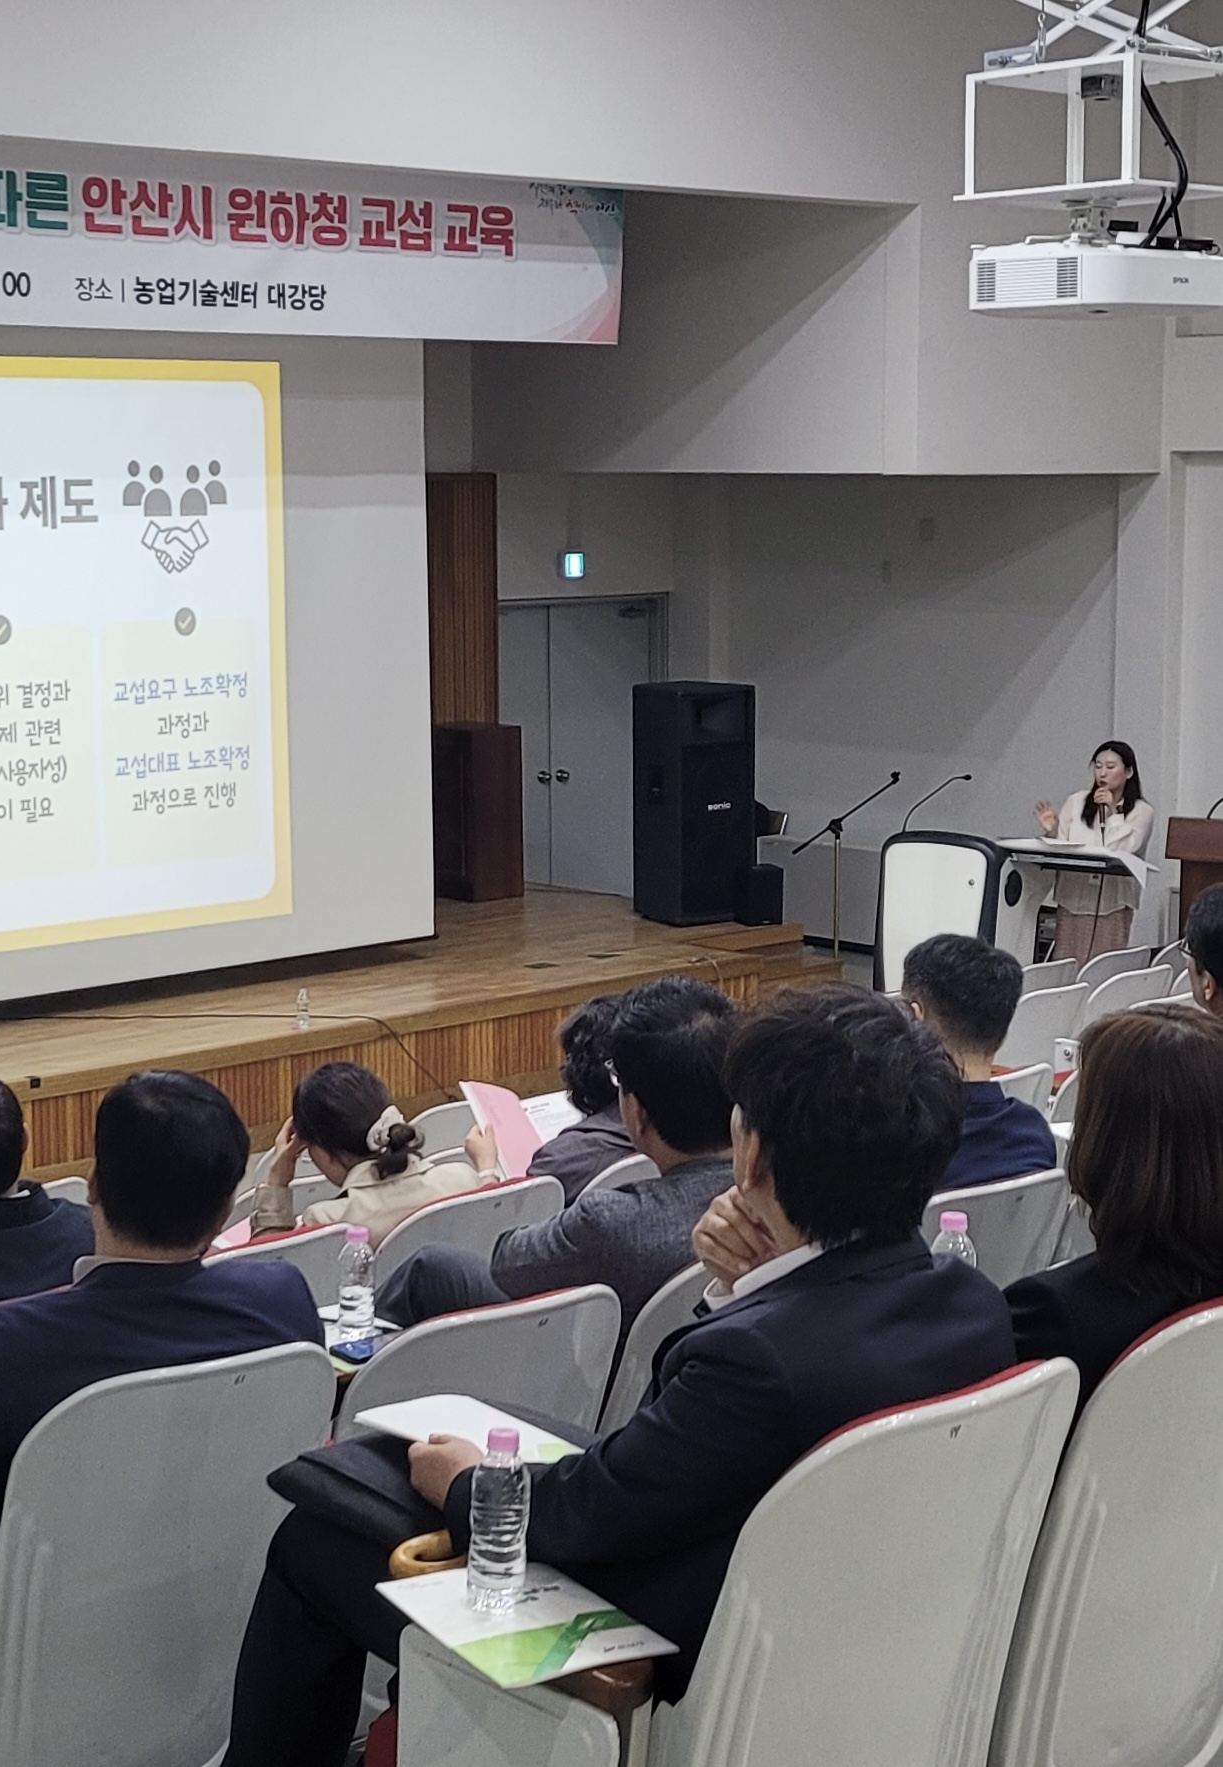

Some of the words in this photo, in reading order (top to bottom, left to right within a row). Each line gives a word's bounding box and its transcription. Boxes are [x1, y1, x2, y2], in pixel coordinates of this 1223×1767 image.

[82, 177, 213, 240] 안산시
[227, 188, 349, 249] 원하청
[359, 198, 432, 252] 교섭
[444, 204, 514, 256] 교육
[75, 277, 113, 301] 장소
[133, 277, 257, 308] 농업기술센터
[268, 283, 326, 311] 대강당
[20, 476, 98, 529] 제도
[16, 680, 70, 708] 결정과
[114, 679, 177, 704] 교섭요구
[184, 672, 247, 698] 노조확정
[26, 718, 60, 746] 관련
[158, 712, 209, 738] 과정과
[115, 752, 181, 779] 교섭대표
[187, 745, 250, 771] 노조확정
[20, 797, 54, 823] 필요
[133, 788, 197, 814] 과정으로
[204, 782, 236, 808] 진행
